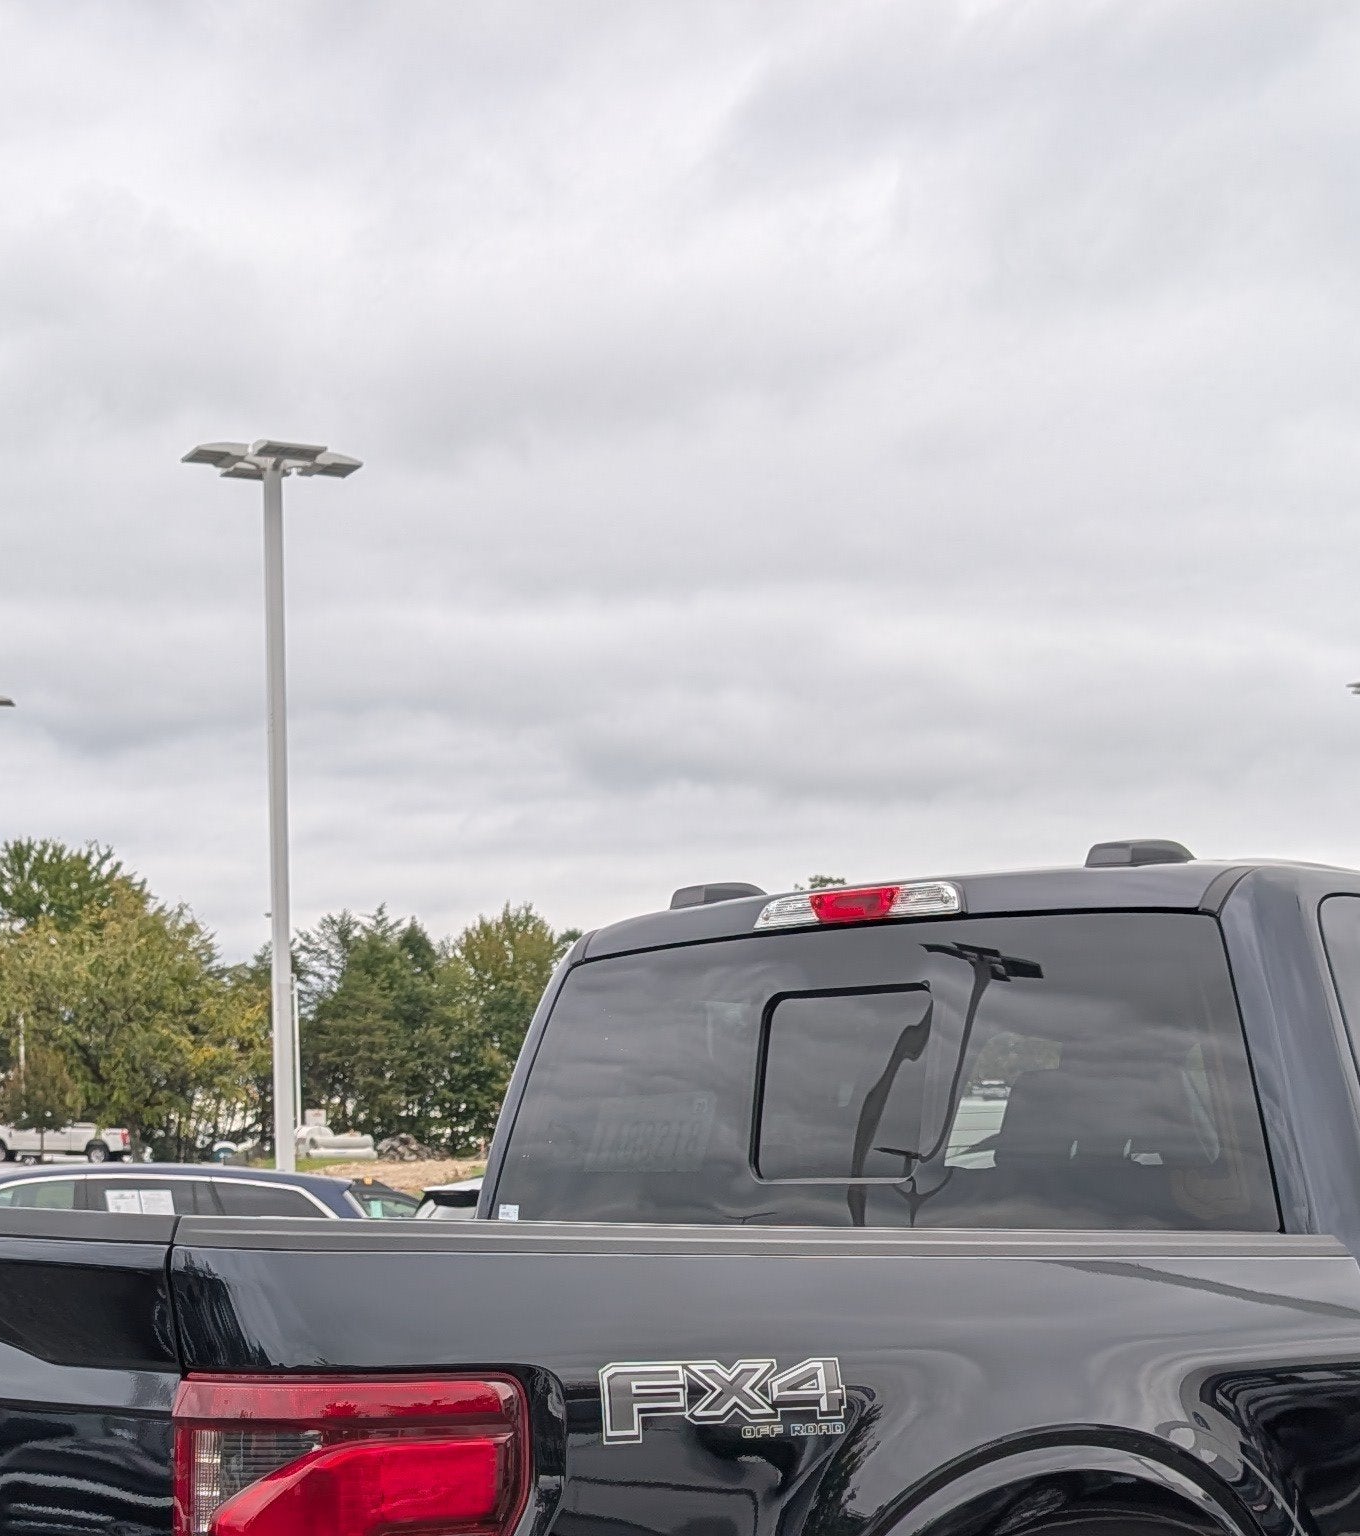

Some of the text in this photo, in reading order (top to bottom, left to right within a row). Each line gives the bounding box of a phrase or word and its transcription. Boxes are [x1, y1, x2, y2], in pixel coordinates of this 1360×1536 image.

[598, 1357, 846, 1446] FX4
[741, 1422, 846, 1439] OFF ROAD
